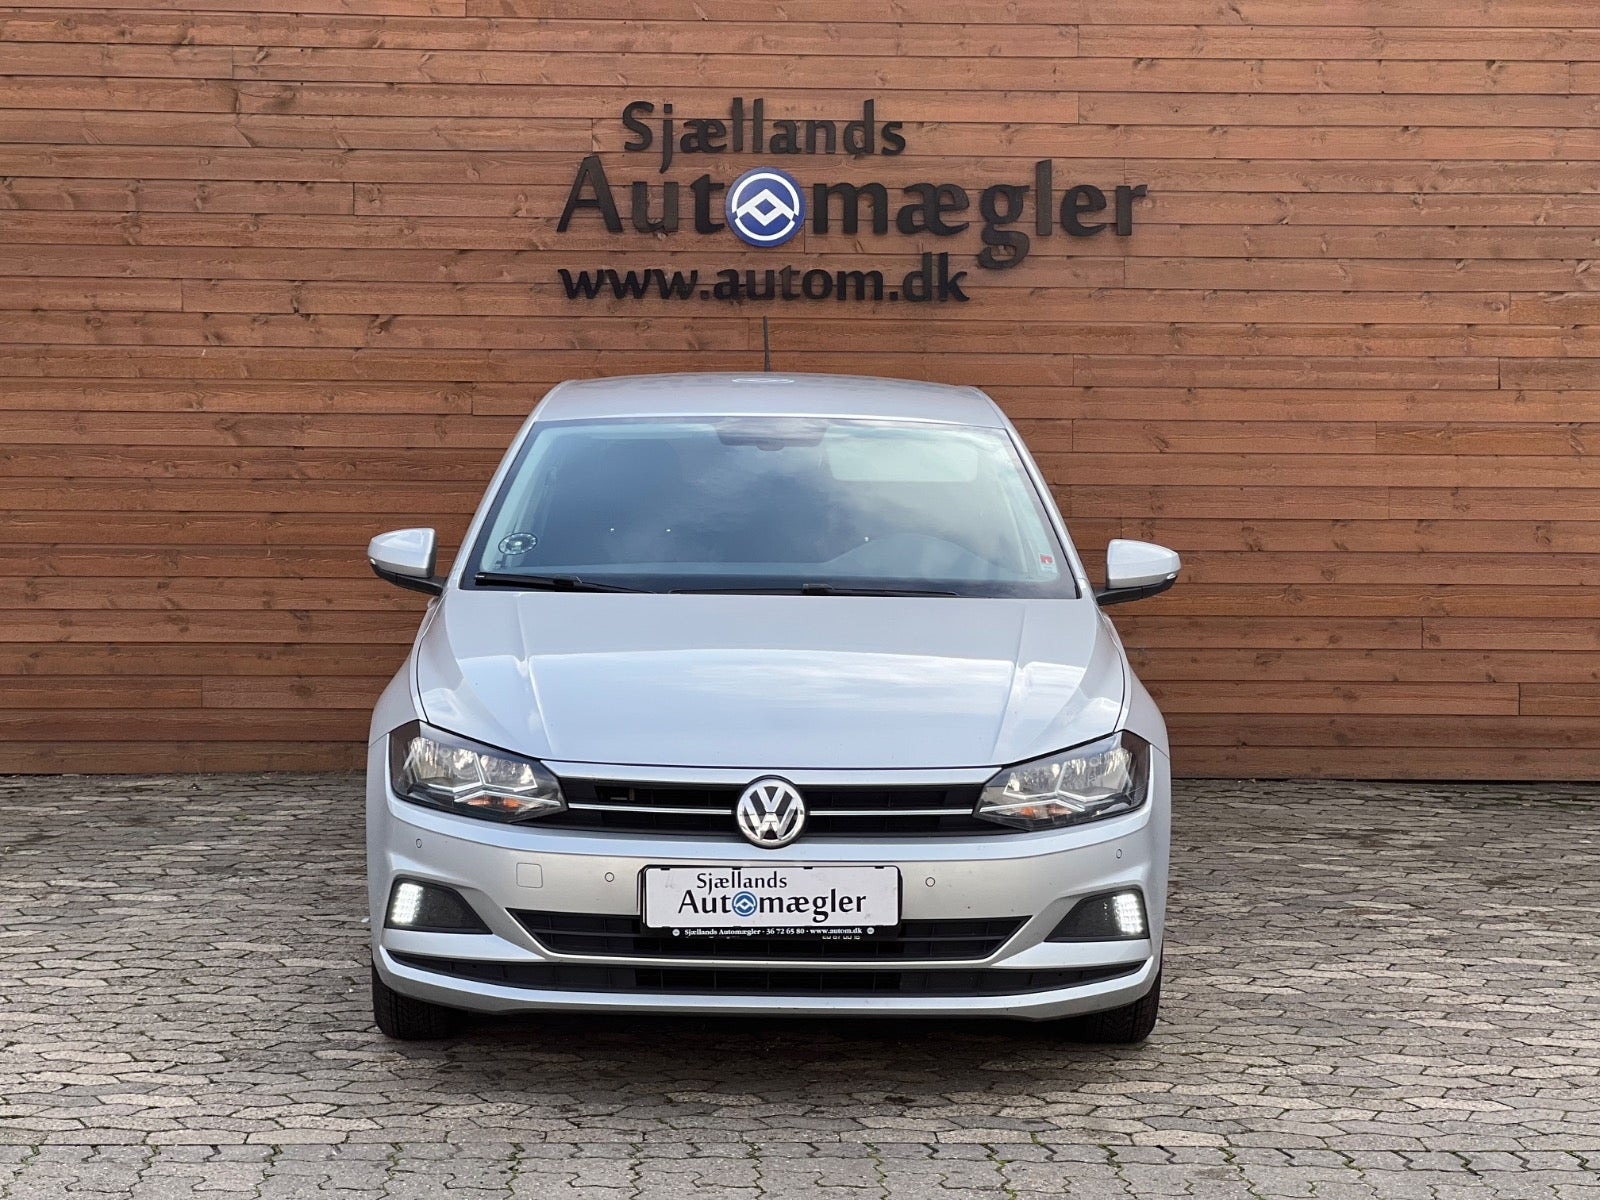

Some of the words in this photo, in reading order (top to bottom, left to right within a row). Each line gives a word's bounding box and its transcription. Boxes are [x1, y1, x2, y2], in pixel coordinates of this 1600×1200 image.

[622, 97, 906, 173] Sjællands
[557, 154, 1148, 269] Automægler
[558, 251, 970, 301] www.autom.dk
[696, 871, 788, 895] Sjællands
[678, 888, 867, 923] Automægler
[684, 928, 718, 936] Sjællands
[719, 928, 760, 936] Automægler
